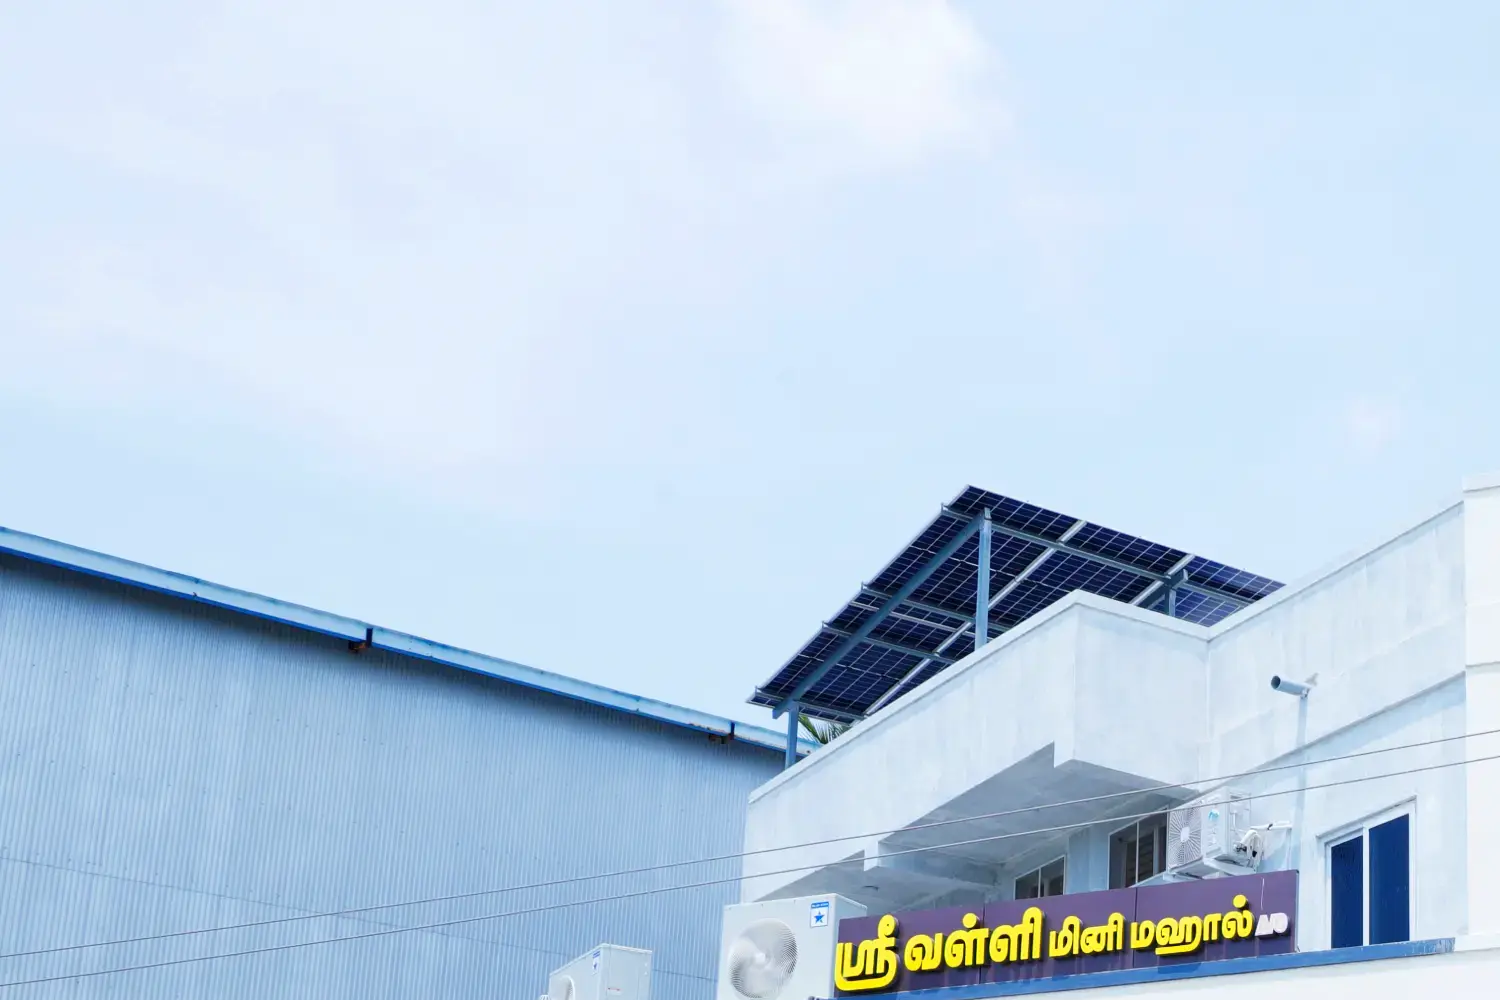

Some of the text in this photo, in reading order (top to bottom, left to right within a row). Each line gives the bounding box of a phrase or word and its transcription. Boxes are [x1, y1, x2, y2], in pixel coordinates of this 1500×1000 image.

[904, 906, 1044, 973] வள்ளி
[1048, 912, 1124, 958] மினி
[1130, 894, 1254, 955] மஹால்
